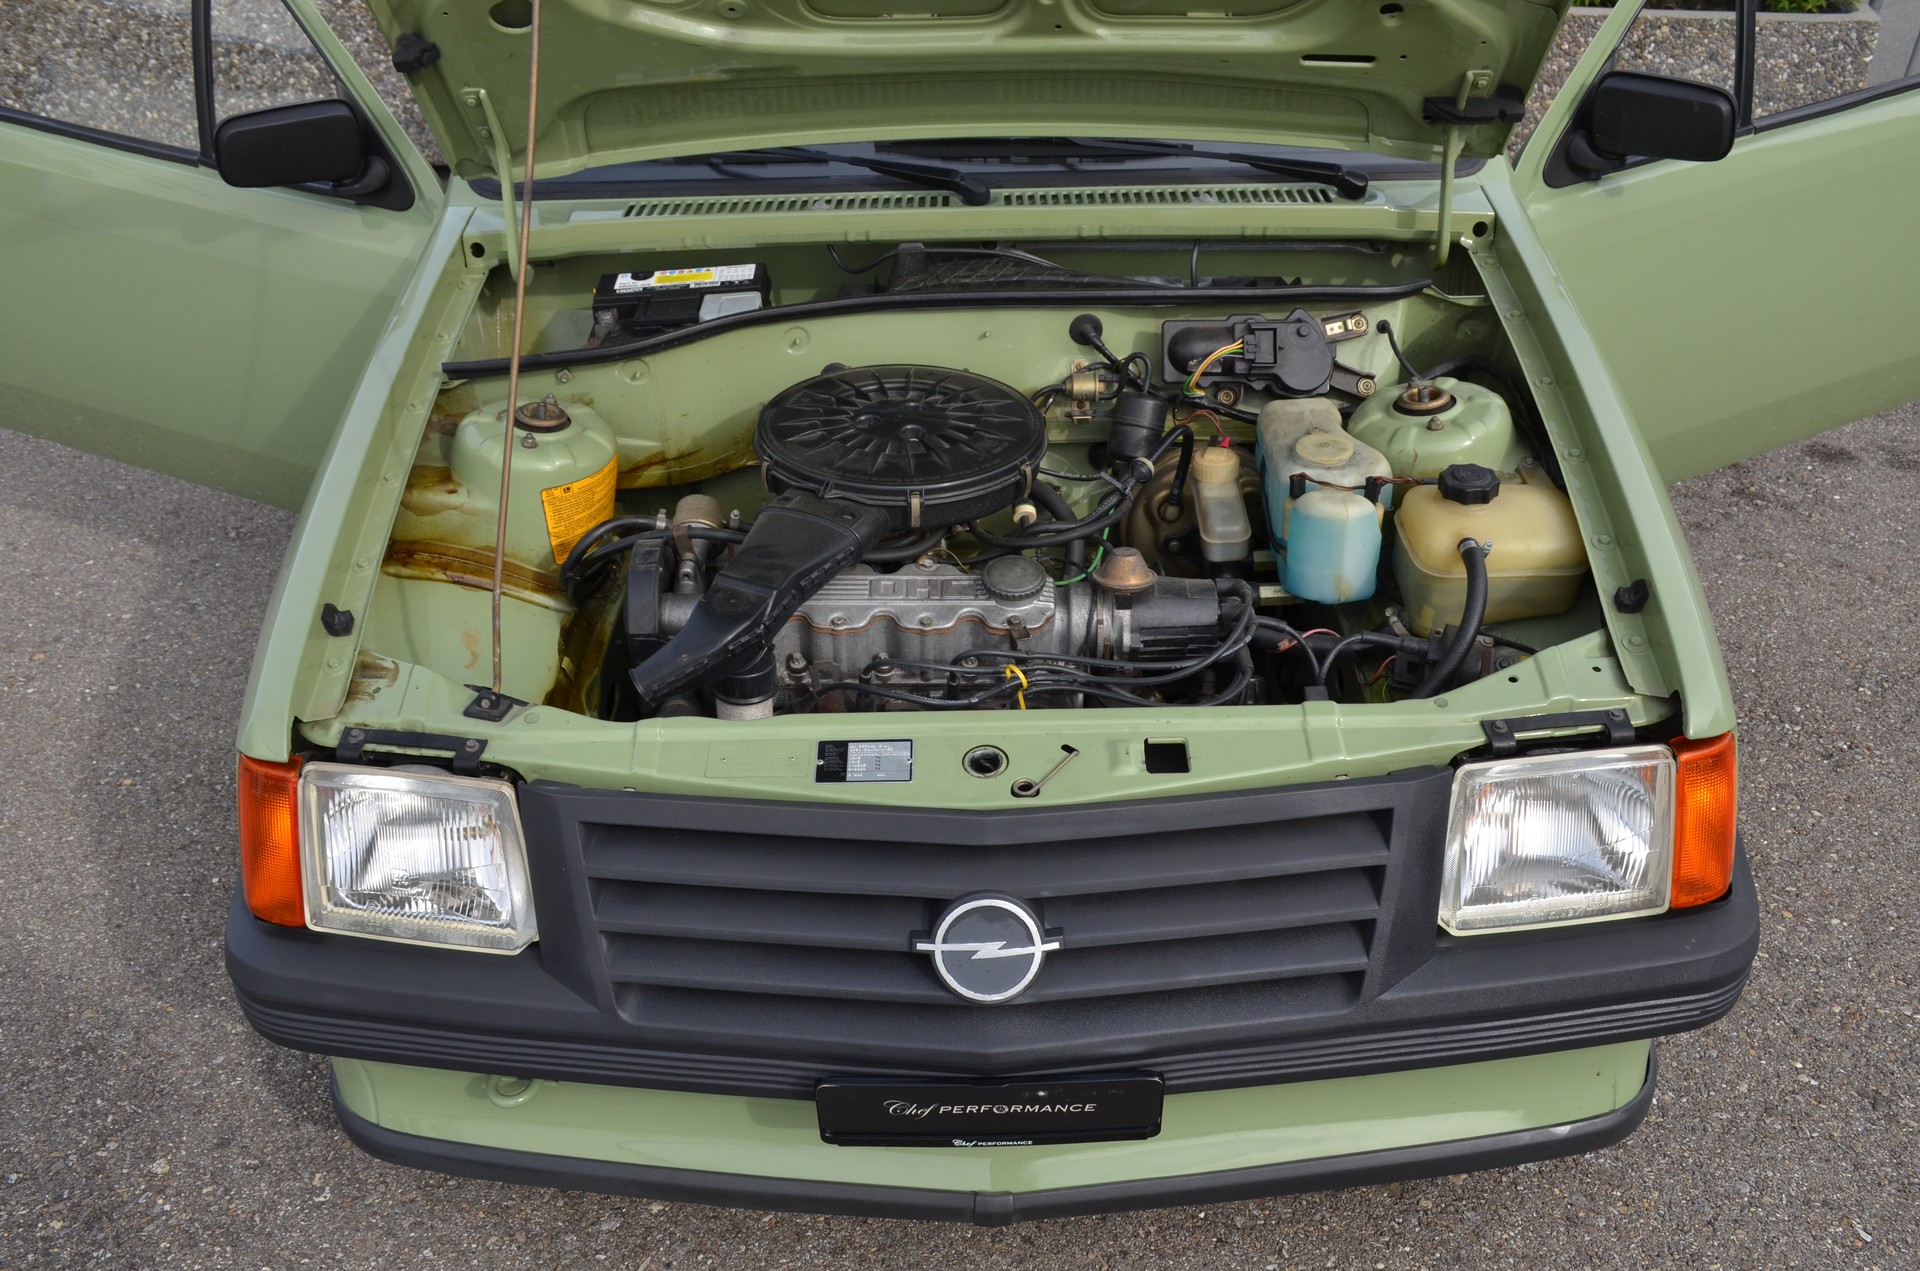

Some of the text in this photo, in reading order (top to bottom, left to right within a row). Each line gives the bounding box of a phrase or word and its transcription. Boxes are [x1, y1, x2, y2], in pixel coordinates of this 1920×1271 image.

[883, 1100, 1097, 1120] Chef PERFORMANCE
[952, 1138, 977, 1147] Chef
